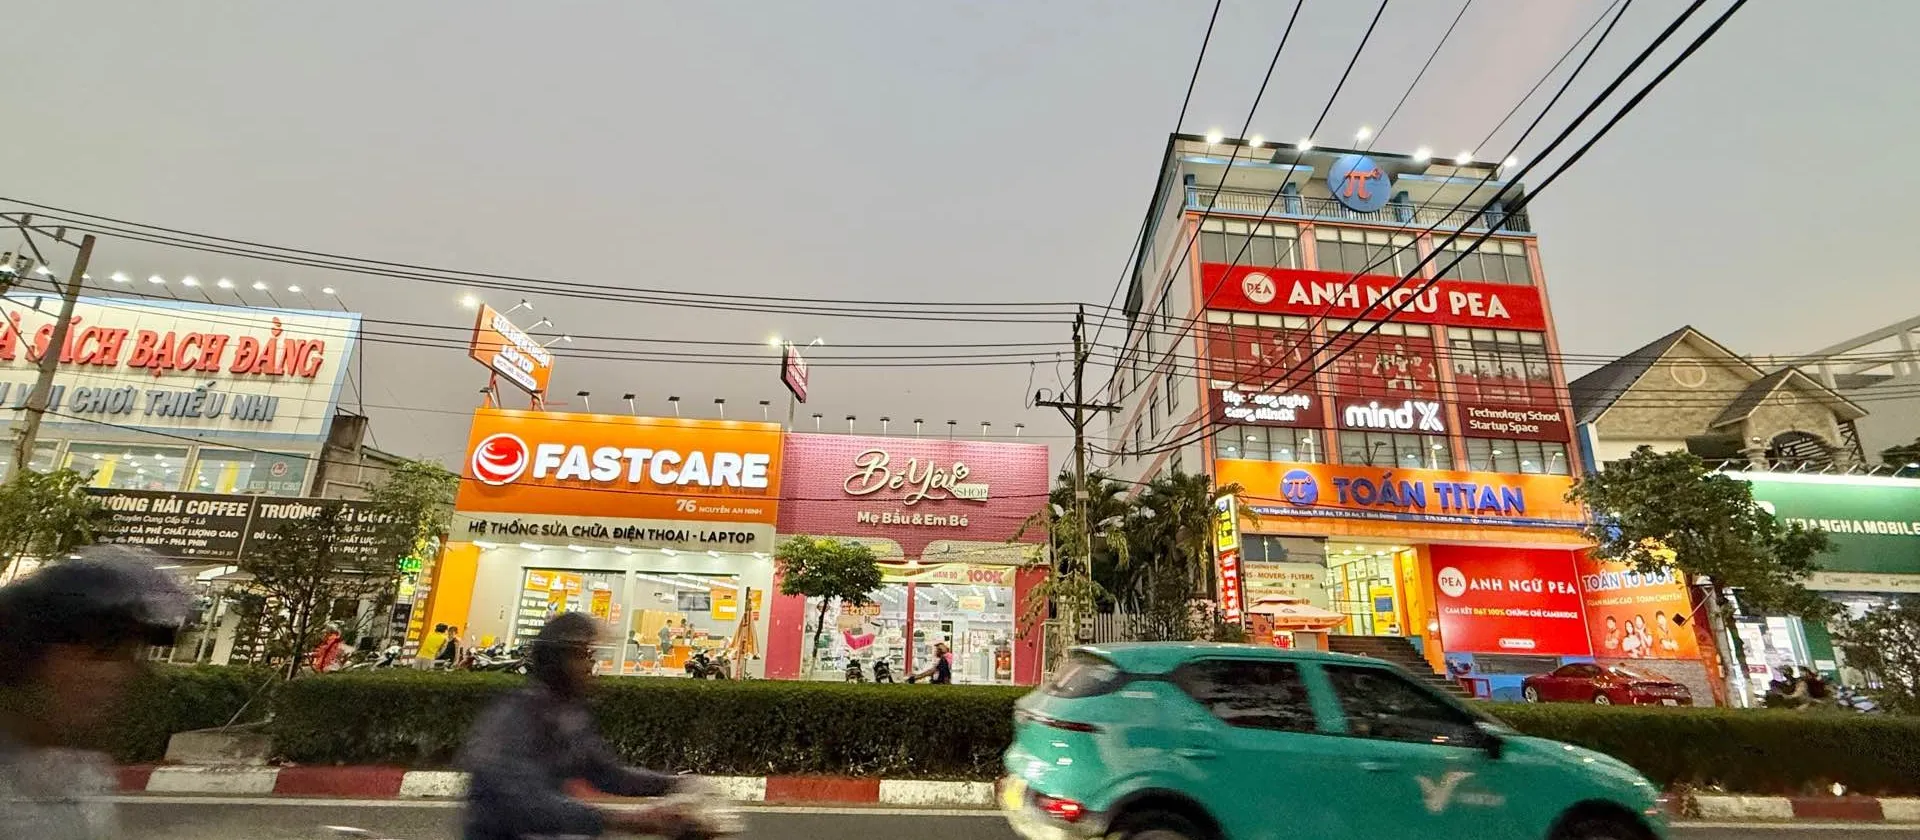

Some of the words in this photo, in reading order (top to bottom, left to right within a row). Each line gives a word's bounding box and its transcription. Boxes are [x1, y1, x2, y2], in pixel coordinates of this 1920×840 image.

[1246, 281, 1272, 295] PEA
[1288, 279, 1360, 309] ANH
[1366, 283, 1440, 314] NGỮ
[1449, 290, 1511, 320] PEA
[127, 329, 231, 378] BẠCH
[69, 384, 139, 415] CHƠI
[145, 380, 227, 419] THIẾU
[230, 394, 280, 422] NHI
[1467, 407, 1527, 422] Technology
[1527, 411, 1561, 422] School
[1469, 419, 1508, 433] Startup
[1508, 421, 1540, 434] Space
[532, 443, 769, 488] FASTCARE
[844, 449, 905, 495] Bé
[903, 457, 957, 505] Yêu
[956, 487, 988, 499] SHOP
[1333, 471, 1426, 508] TOÁN
[1433, 481, 1526, 514] TITAN
[152, 495, 183, 514] HẢI
[186, 500, 249, 517] COFFEE
[676, 499, 697, 513] 76
[857, 511, 881, 526] Mẹ
[882, 509, 910, 525] Bầu
[912, 515, 924, 526] &
[924, 515, 947, 526] Em
[949, 514, 969, 527] Bé
[219, 531, 239, 539] CAO
[468, 519, 488, 536] HỆ
[490, 518, 539, 536] THỐNG
[541, 520, 568, 537] SỬA
[572, 522, 610, 539] CHỮA
[613, 525, 645, 542] ĐIỆN
[648, 528, 690, 544] THOẠI
[700, 531, 756, 544] LAPTOP
[127, 536, 144, 544] PHA
[169, 539, 186, 547] PHA
[187, 540, 208, 548] PHIN
[1258, 572, 1286, 580] MOVERS
[1441, 577, 1462, 587] PEA
[1470, 577, 1503, 591] ANH
[1508, 578, 1544, 593] NGỮ
[1548, 581, 1577, 595] PEA
[1583, 569, 1620, 593] TOÁN
[1445, 607, 1460, 615] CAM
[1541, 611, 1578, 619] CAMBRIDGE
